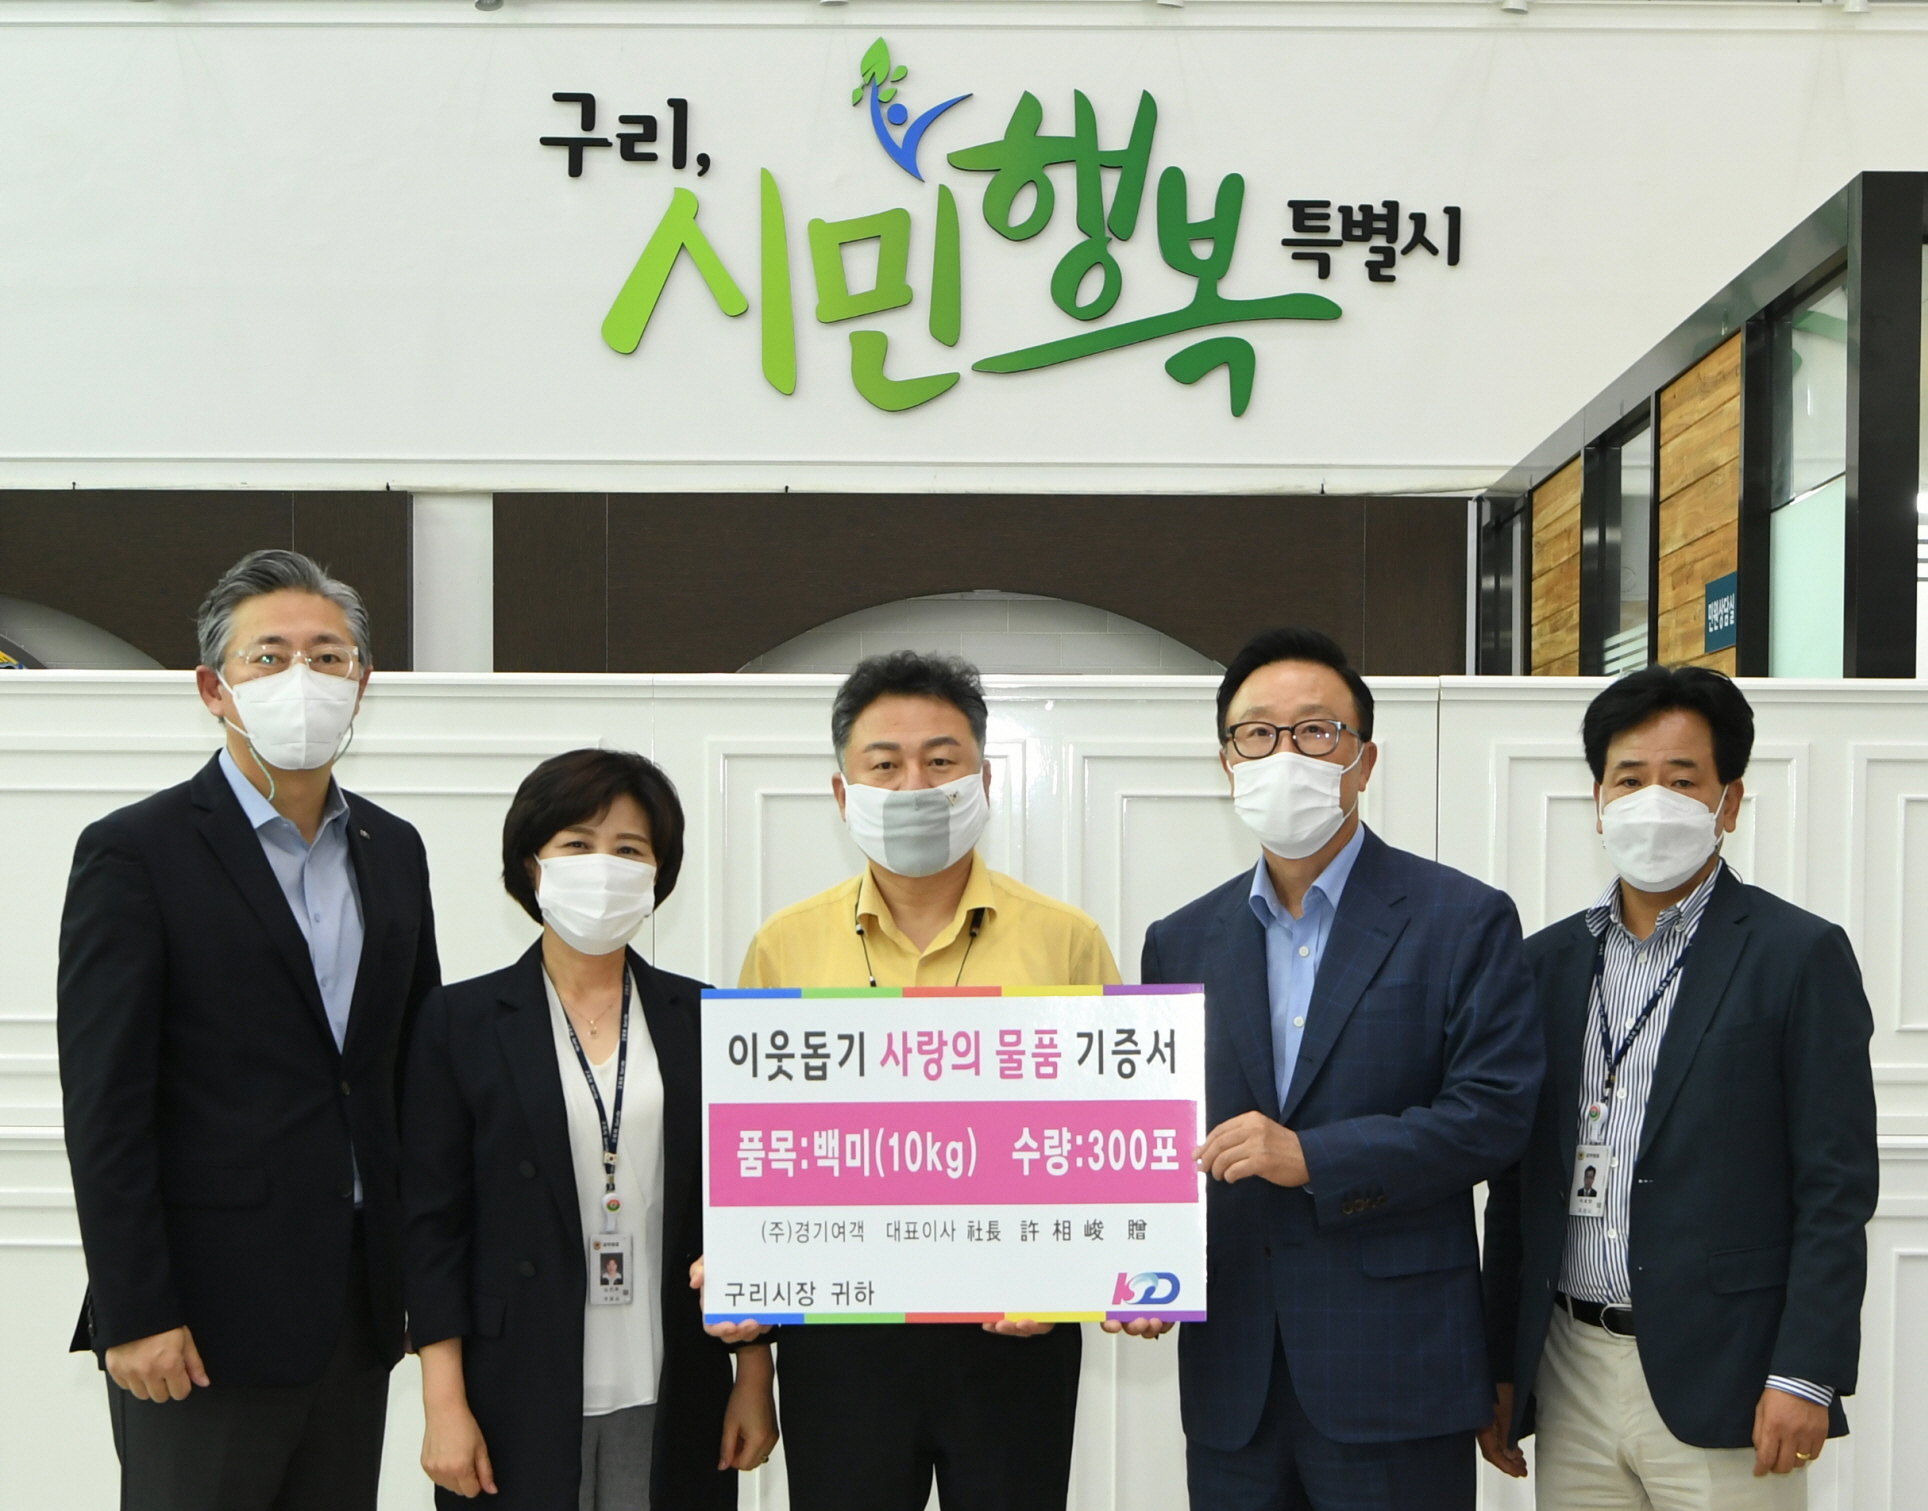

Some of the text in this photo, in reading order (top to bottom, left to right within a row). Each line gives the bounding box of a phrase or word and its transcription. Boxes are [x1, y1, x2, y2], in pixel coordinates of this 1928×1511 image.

[540, 92, 711, 178] 구리,
[1281, 199, 1462, 283] 특별시
[728, 1029, 1176, 1082] 이웃돕기 사랑의 물품 기증서
[736, 1127, 1180, 1179] 품목:백미(10kg) 수량:300포
[761, 1220, 865, 1244] (주)경기여객
[886, 1220, 956, 1243] 대표이사
[967, 1220, 1001, 1242] 社長
[724, 1280, 875, 1307] 구리시장 귀하
